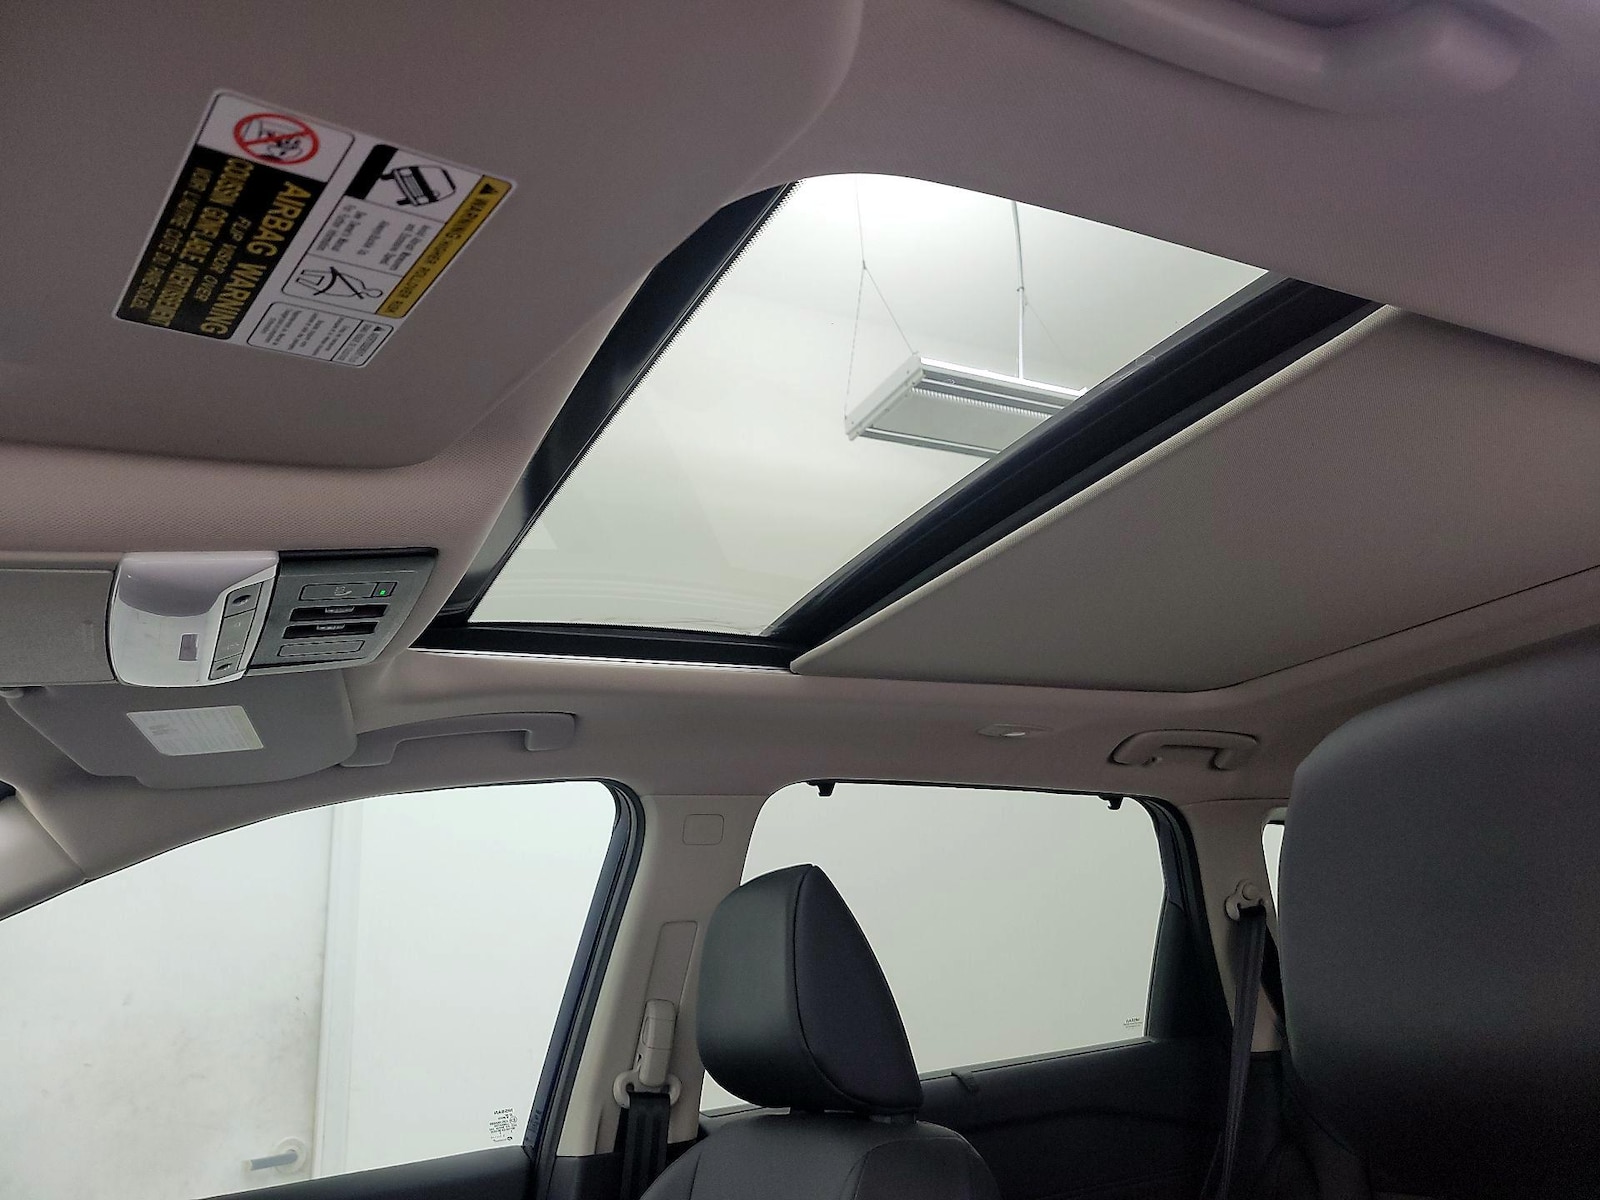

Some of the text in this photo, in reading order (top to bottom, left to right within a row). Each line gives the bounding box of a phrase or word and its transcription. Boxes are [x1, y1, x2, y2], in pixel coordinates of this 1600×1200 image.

[243, 180, 315, 258] AIRBAG
[191, 215, 253, 302] FLIP VISOR OVER
[197, 259, 267, 336] WARNING
